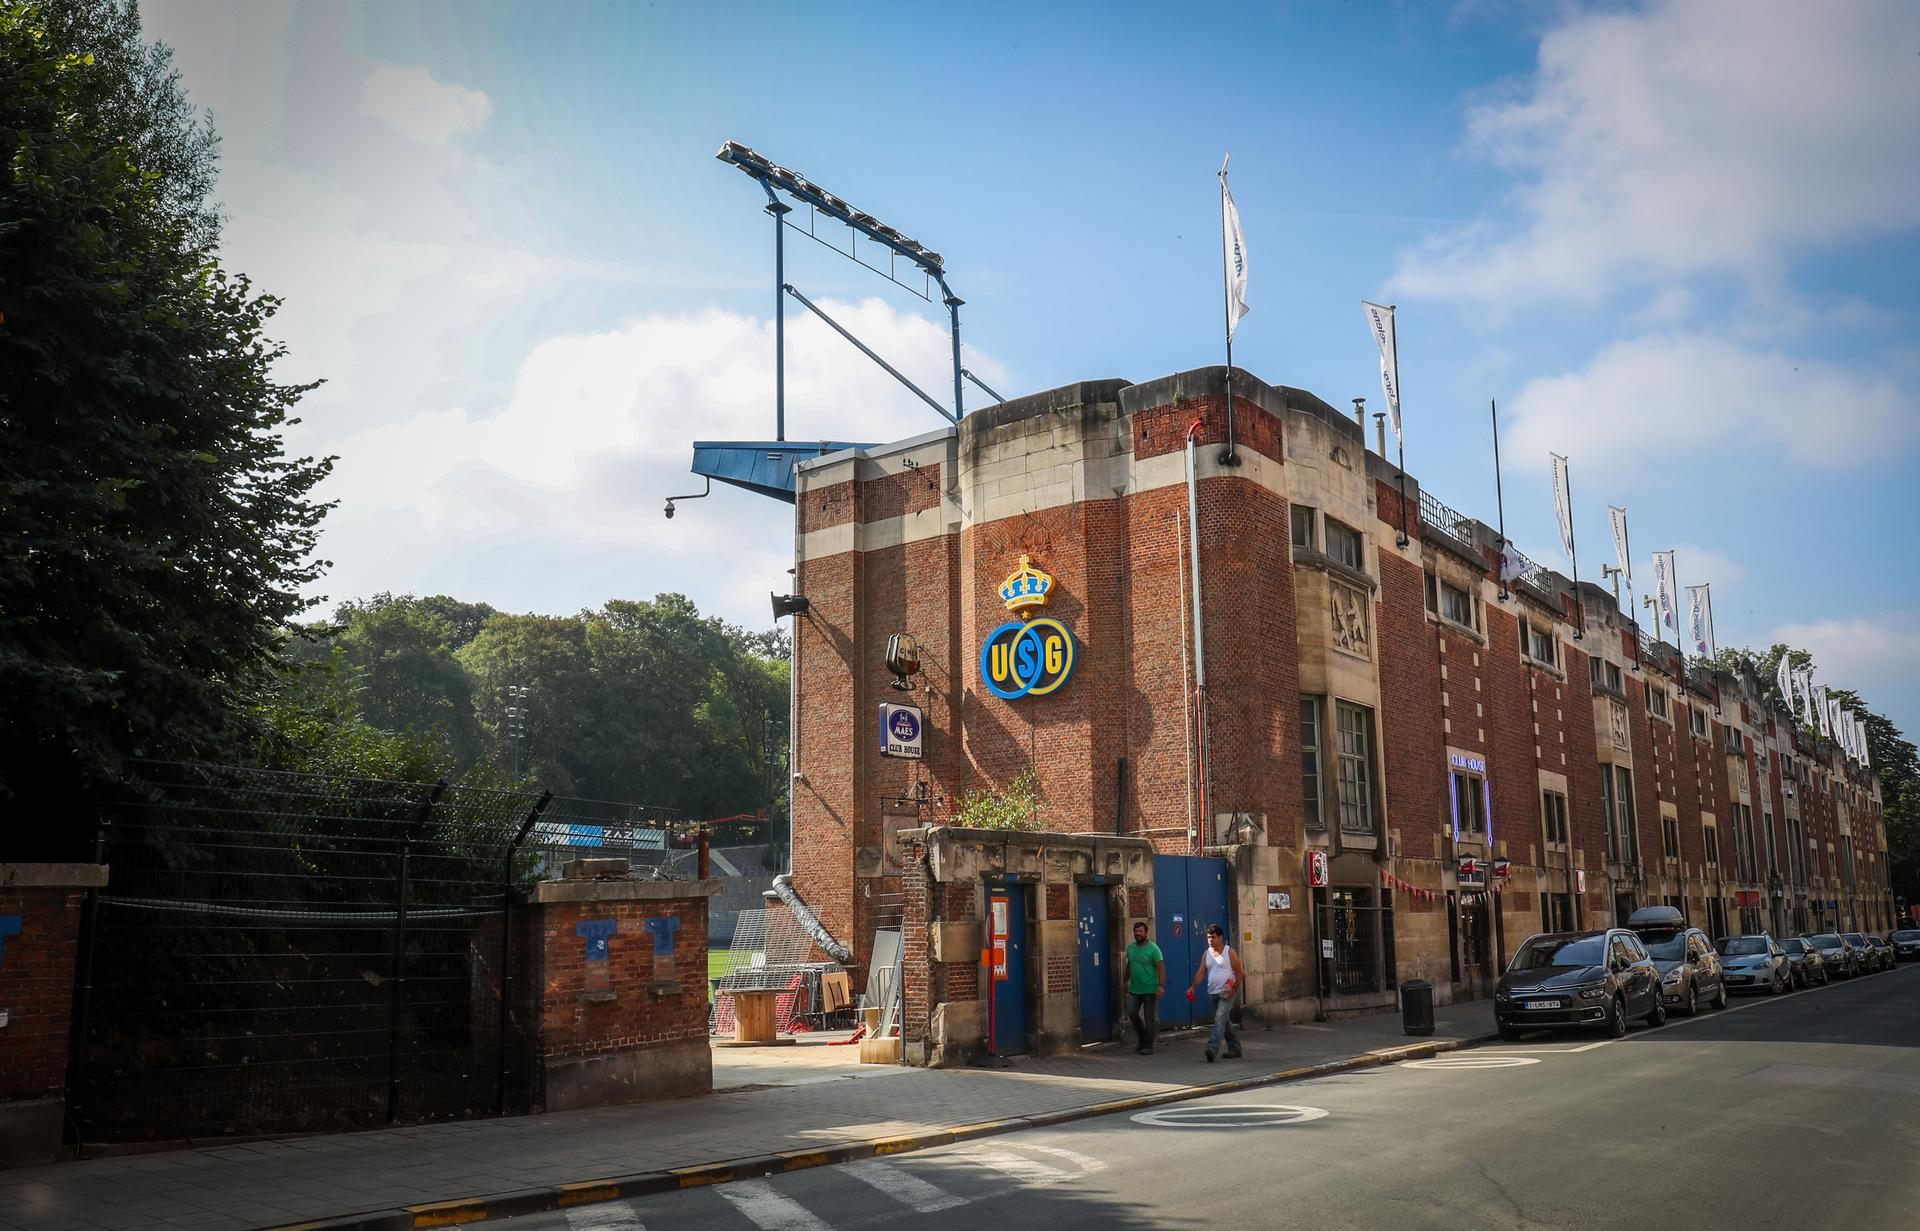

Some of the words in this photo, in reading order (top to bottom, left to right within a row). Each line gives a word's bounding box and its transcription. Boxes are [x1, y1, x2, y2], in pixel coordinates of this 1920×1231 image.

[991, 635, 1062, 682] USG
[894, 726, 913, 735] MAES
[889, 743, 903, 752] CLUB
[903, 745, 921, 755] HOUSE
[1451, 753, 1467, 768] CLUB
[1467, 758, 1486, 773] HOUSE
